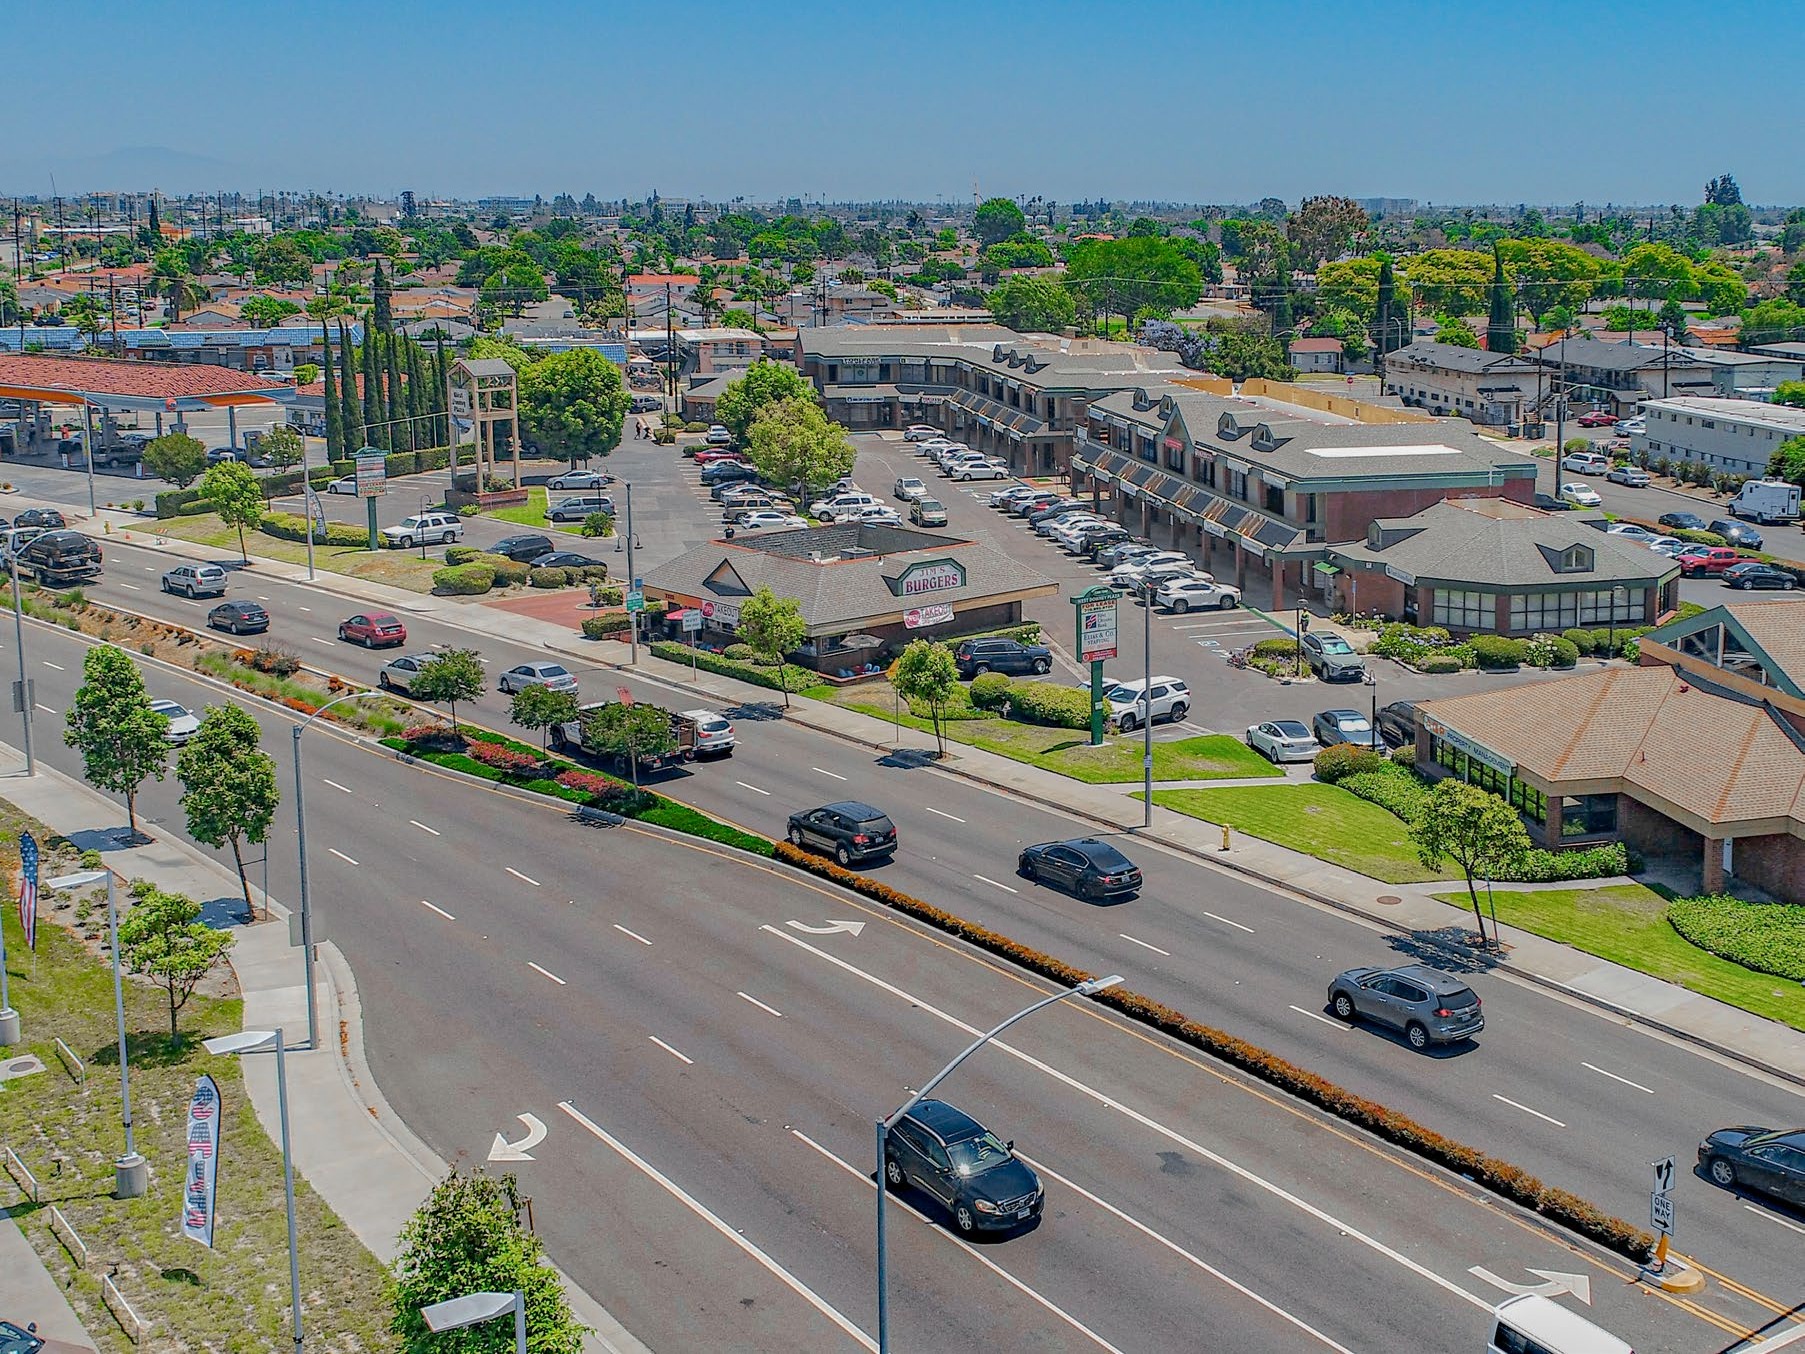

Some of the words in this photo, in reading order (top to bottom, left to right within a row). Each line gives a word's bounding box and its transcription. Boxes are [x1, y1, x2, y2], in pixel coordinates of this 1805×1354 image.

[920, 566, 945, 577] JIM'S
[905, 573, 958, 593] BURGERS
[714, 603, 738, 617] TAKEOUT
[920, 603, 952, 619] TAKEOUT
[1447, 731, 1471, 749] PROPERTY
[1473, 747, 1510, 770] MANAGEMENT
[1654, 1197, 1670, 1211] ONE
[1654, 1207, 1670, 1220] WAY
